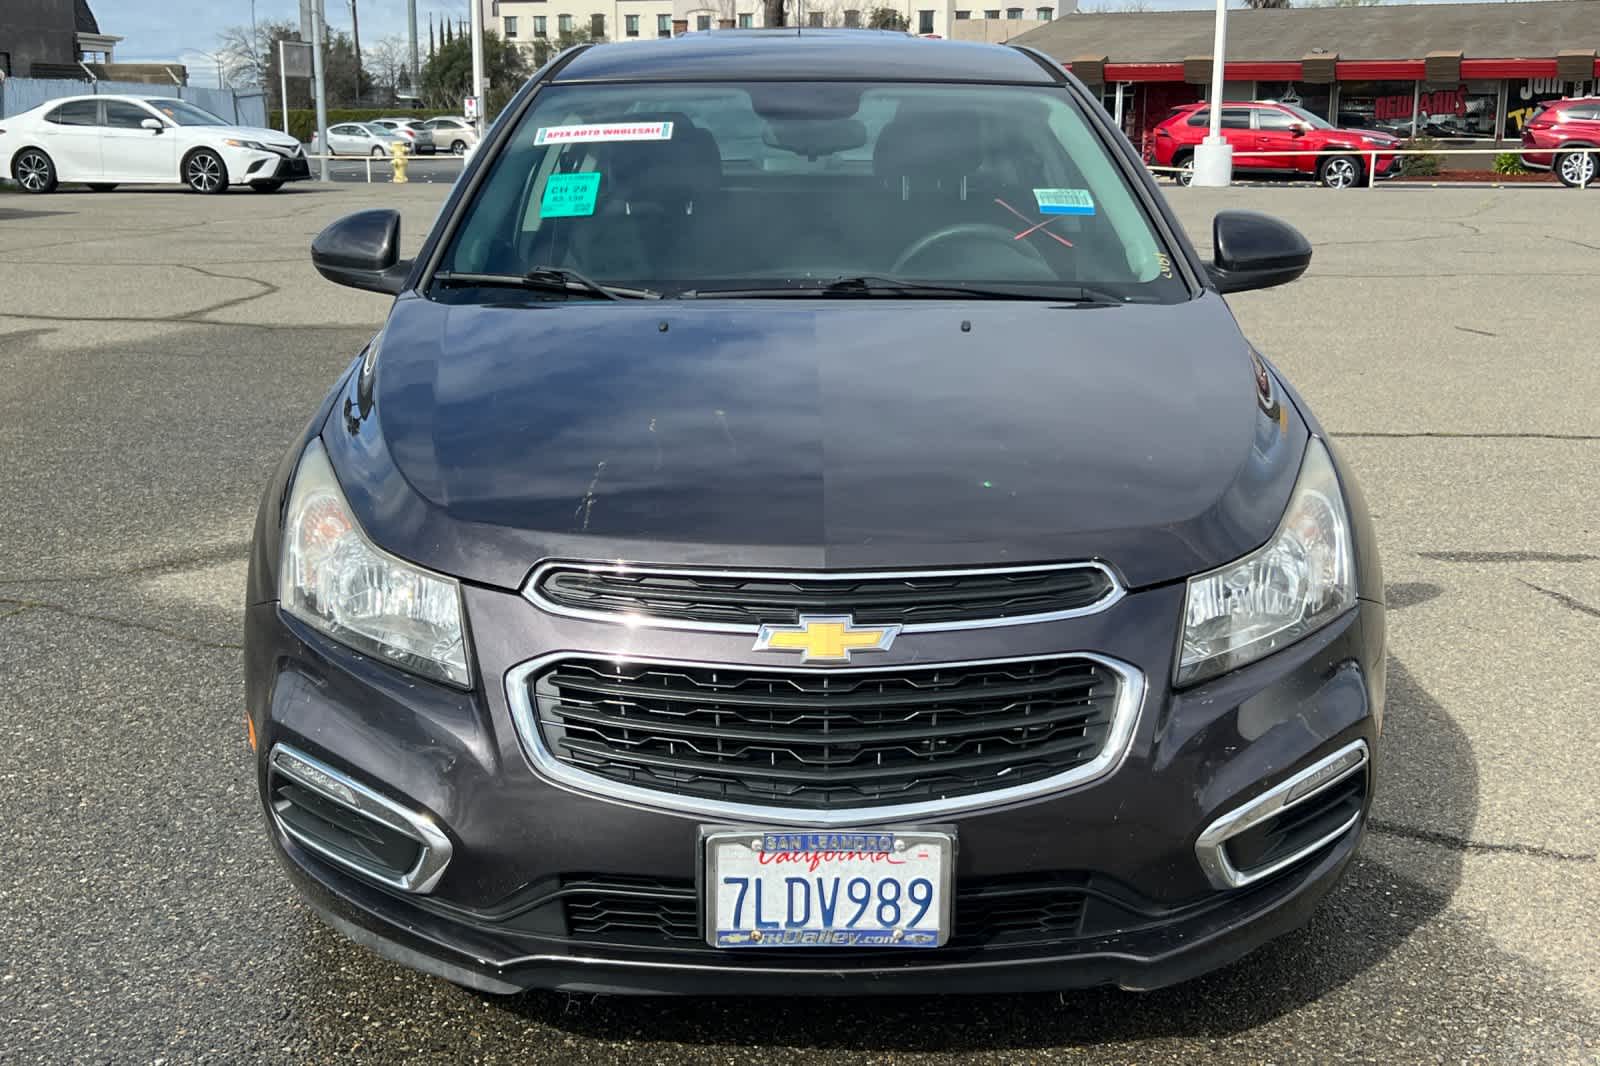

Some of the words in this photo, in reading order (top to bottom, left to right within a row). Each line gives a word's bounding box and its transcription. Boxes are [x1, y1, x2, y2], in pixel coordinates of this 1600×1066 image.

[546, 131, 571, 139] APEX
[574, 129, 600, 137] AUTO
[602, 127, 661, 136] WHOLESALE
[766, 836, 801, 850] SAN
[807, 836, 891, 850] LEANDRO
[723, 877, 934, 929] 7LDV989
